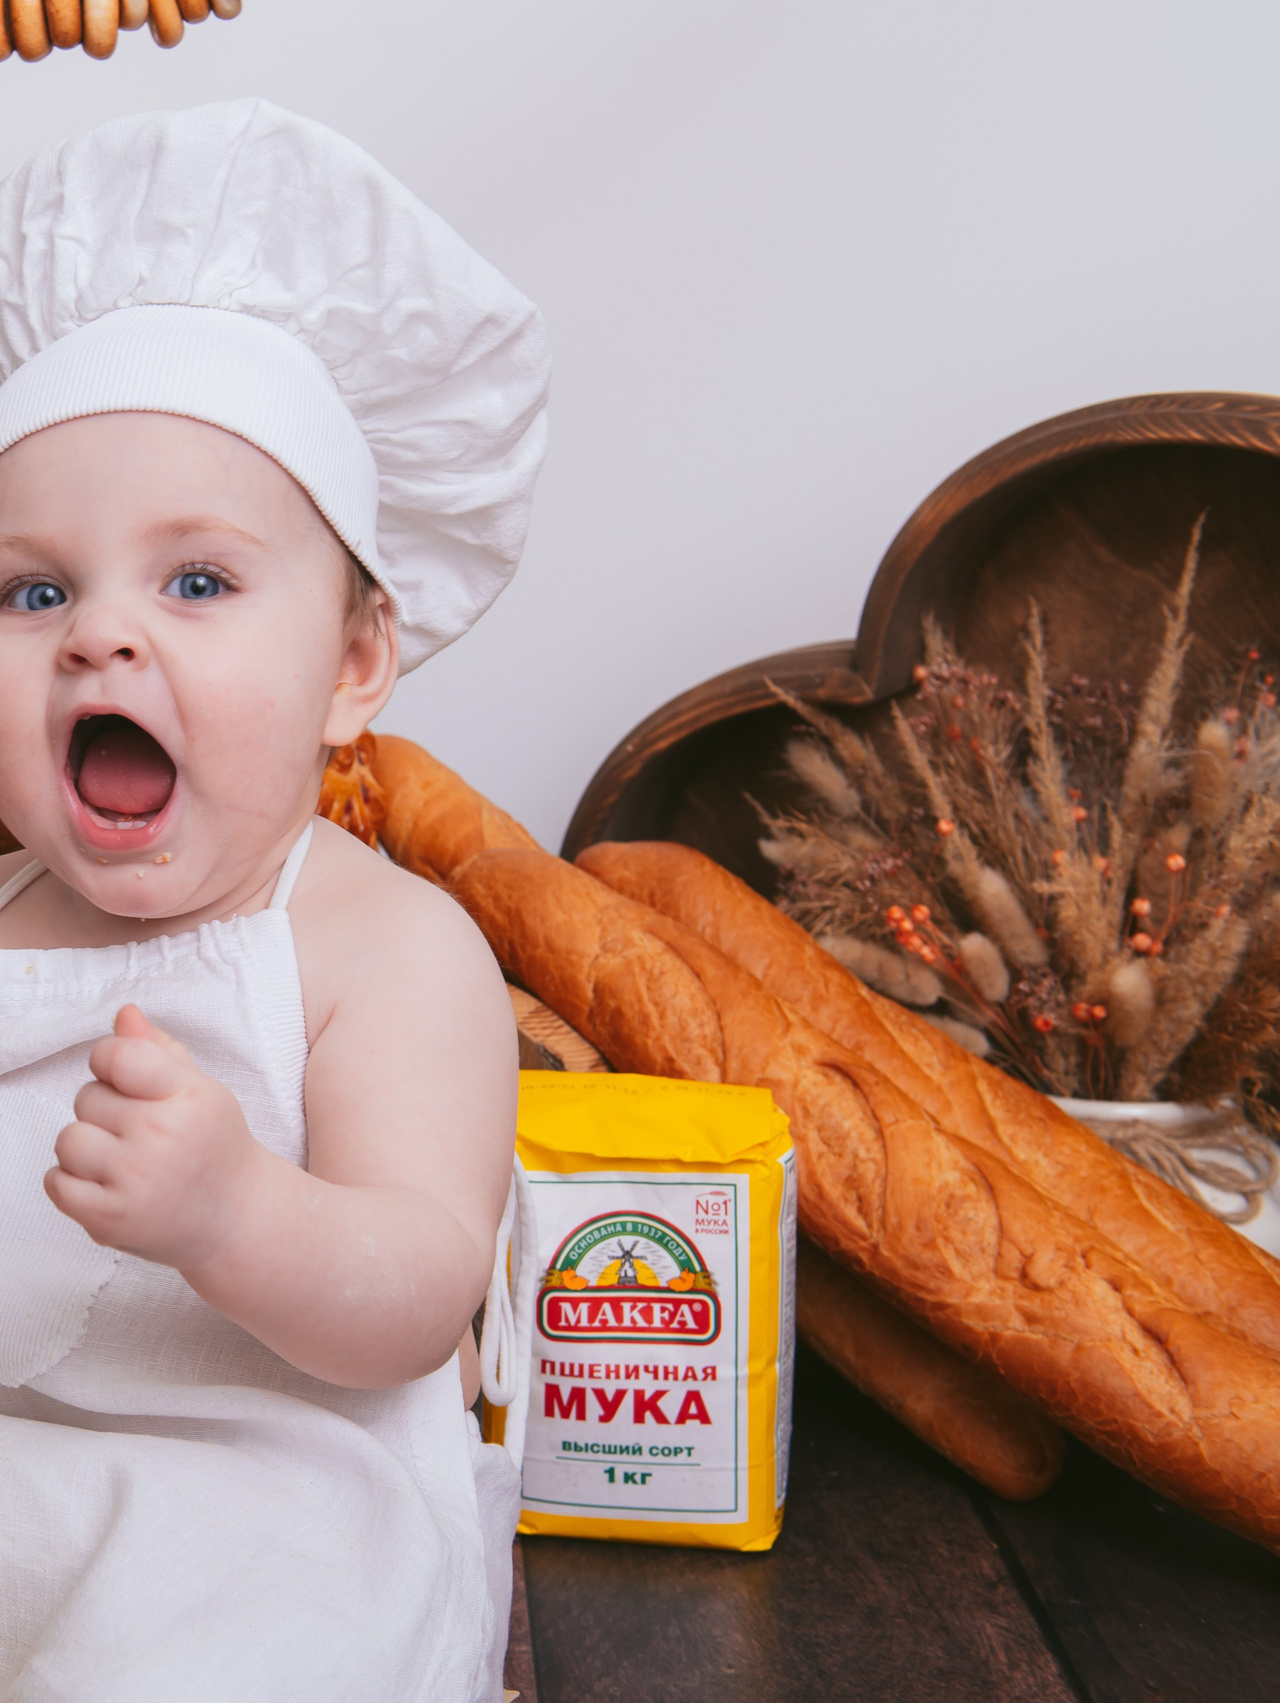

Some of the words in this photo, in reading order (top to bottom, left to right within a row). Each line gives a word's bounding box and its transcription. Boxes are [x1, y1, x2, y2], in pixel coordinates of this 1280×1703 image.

[695, 1218, 729, 1227] МУКА
[569, 1223, 623, 1260] ОСНОВАНА
[626, 1222, 633, 1232] В
[637, 1223, 662, 1239] 1937
[663, 1236, 688, 1261] ГОДУ
[540, 1358, 717, 1382] ПШЕНИЧНАЯ
[544, 1382, 712, 1425] МУКА
[561, 1440, 643, 1457] ВЫСШИЙ
[648, 1445, 695, 1458] СОРТ
[603, 1466, 616, 1484] 1
